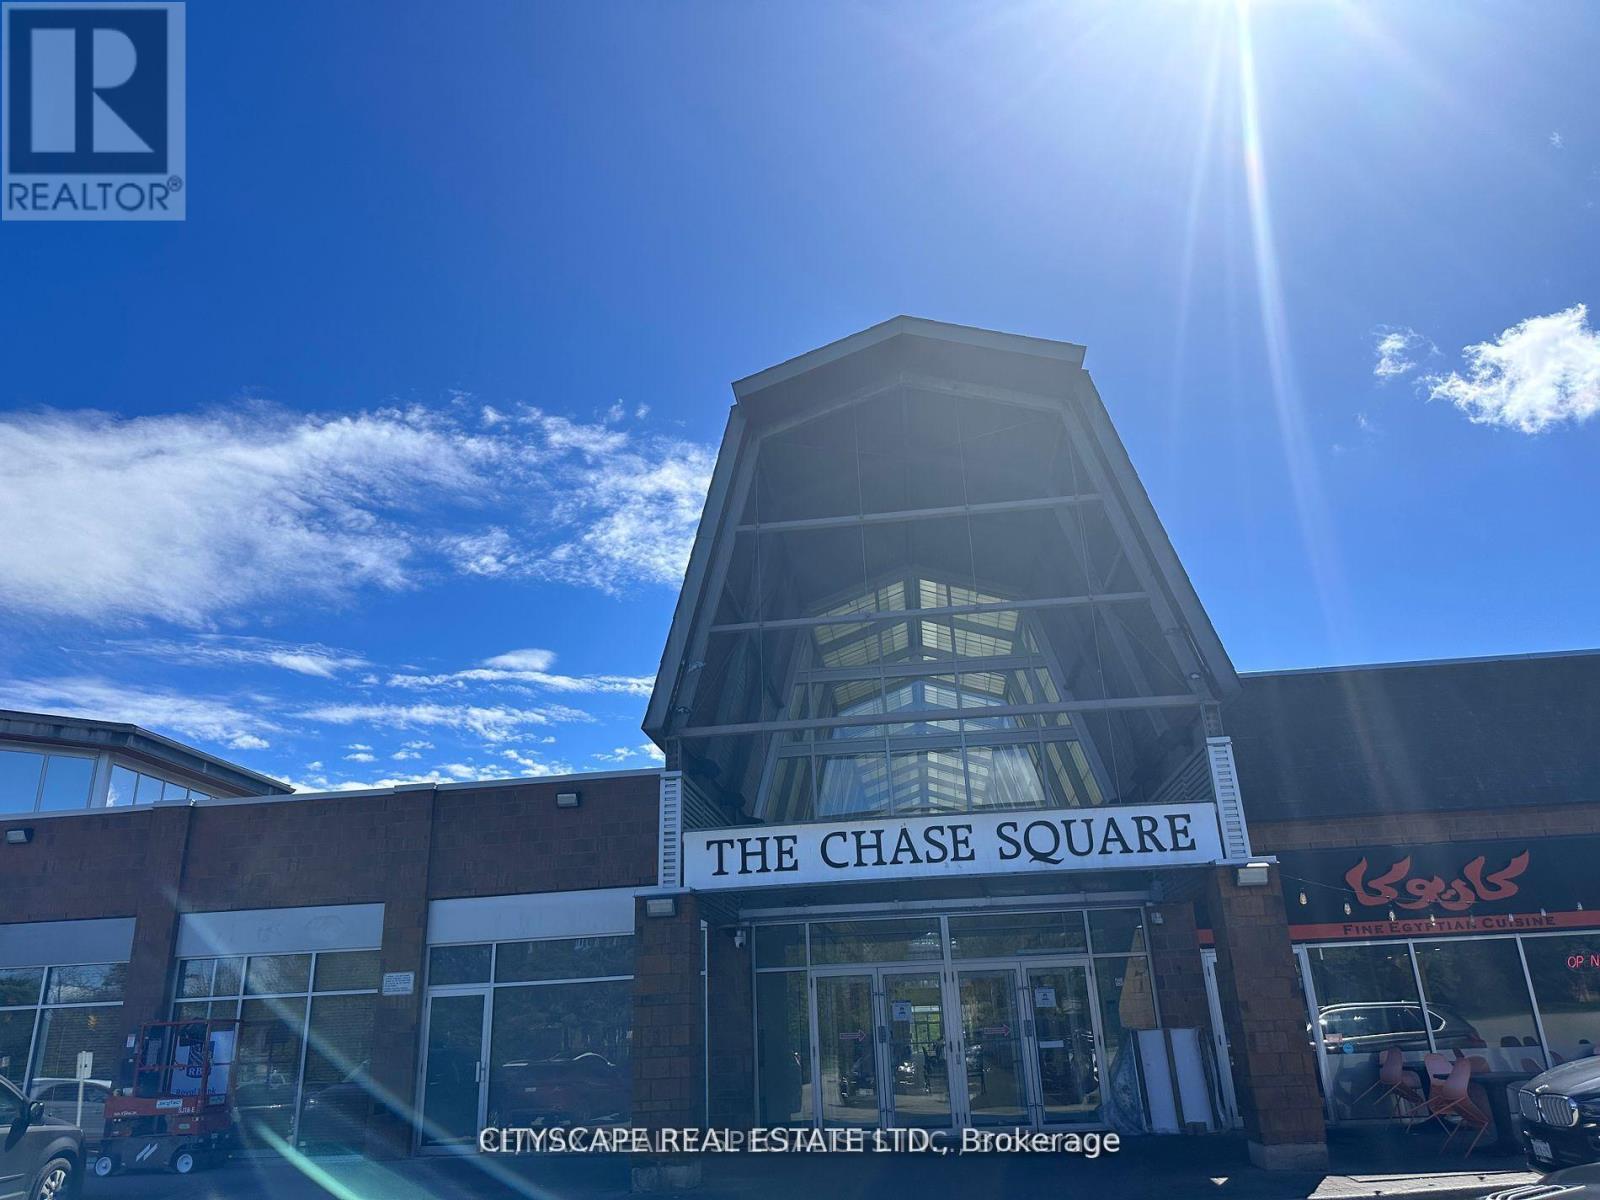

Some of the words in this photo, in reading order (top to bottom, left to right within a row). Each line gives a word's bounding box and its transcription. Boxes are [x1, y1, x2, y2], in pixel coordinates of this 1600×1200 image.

[706, 834, 799, 876] THE
[819, 823, 976, 868] CHASE
[997, 813, 1197, 866] SQUARE
[1567, 954, 1600, 968] OPN
